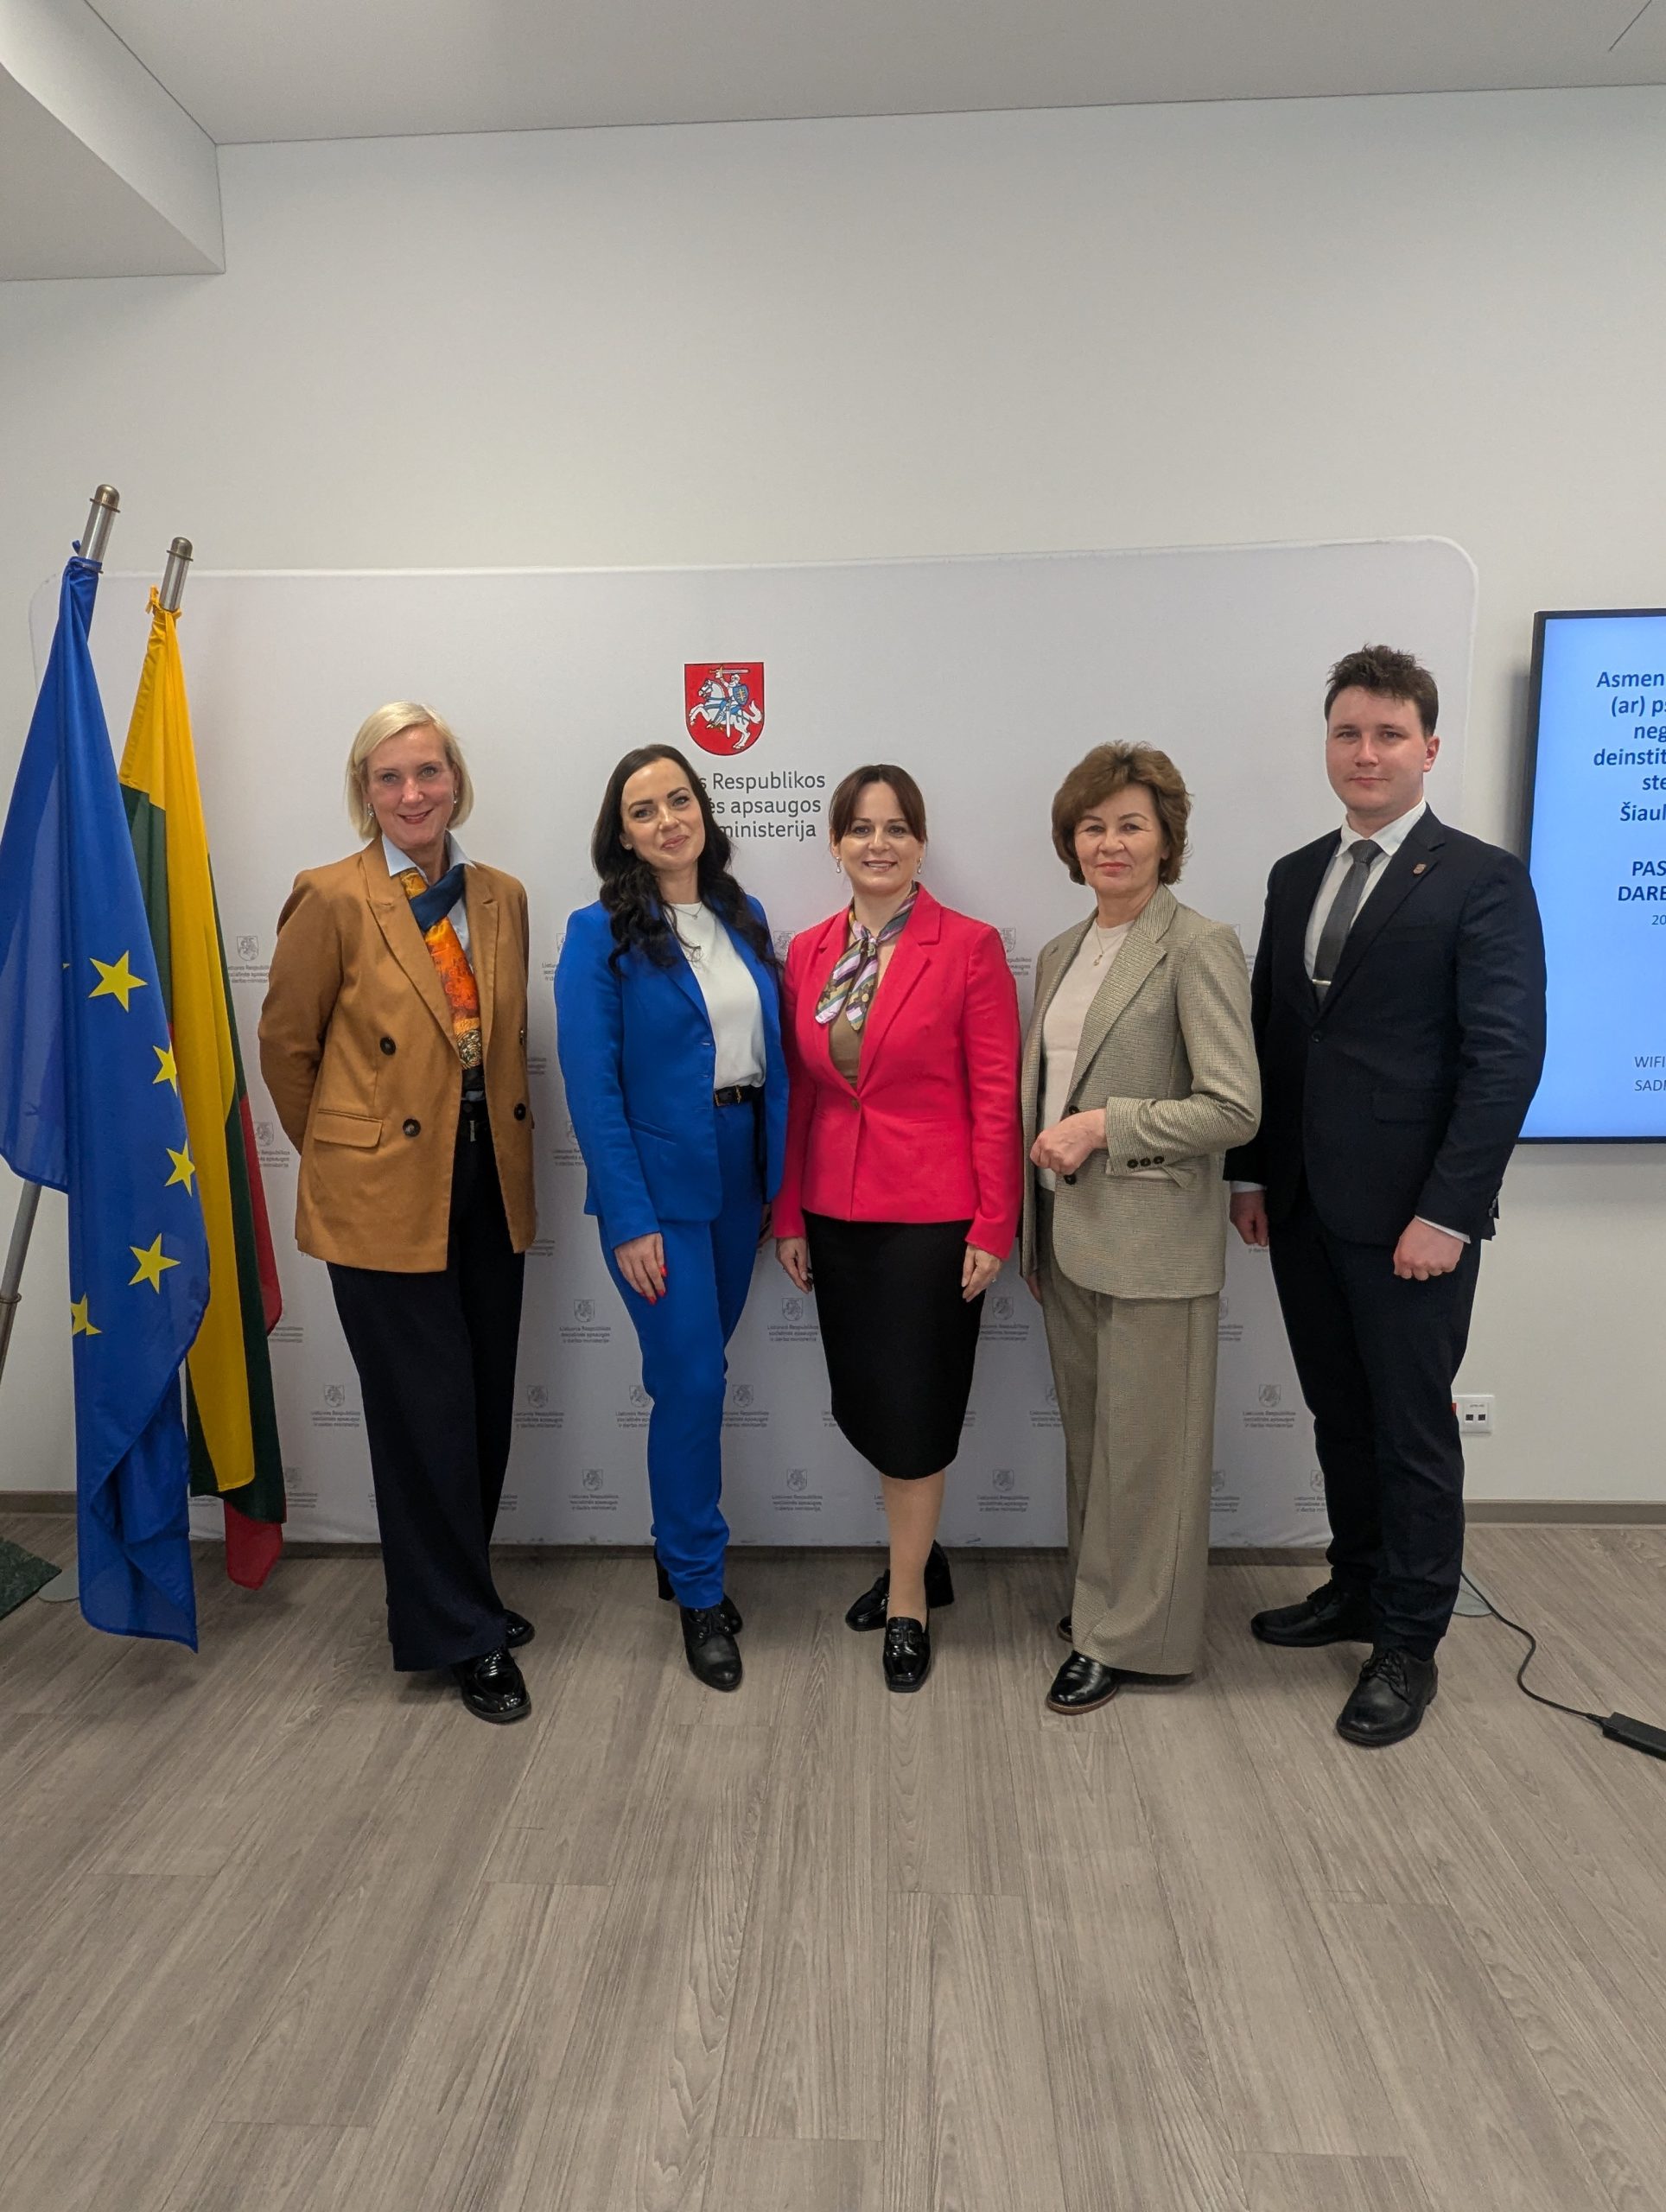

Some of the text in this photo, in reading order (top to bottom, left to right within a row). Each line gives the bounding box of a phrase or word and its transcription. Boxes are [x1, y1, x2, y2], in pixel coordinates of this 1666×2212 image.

[1596, 671, 1664, 688] Asmen
[1611, 696, 1666, 717] (ar) p
[1633, 725, 1666, 743] neg
[1593, 747, 1666, 766] deinstit
[713, 771, 825, 794] Respublikos
[730, 799, 821, 818] apsaugos
[1631, 861, 1666, 876] PAS
[1651, 914, 1666, 925] 20
[1634, 1056, 1665, 1068] WIFI
[1634, 1079, 1666, 1091] SAD
